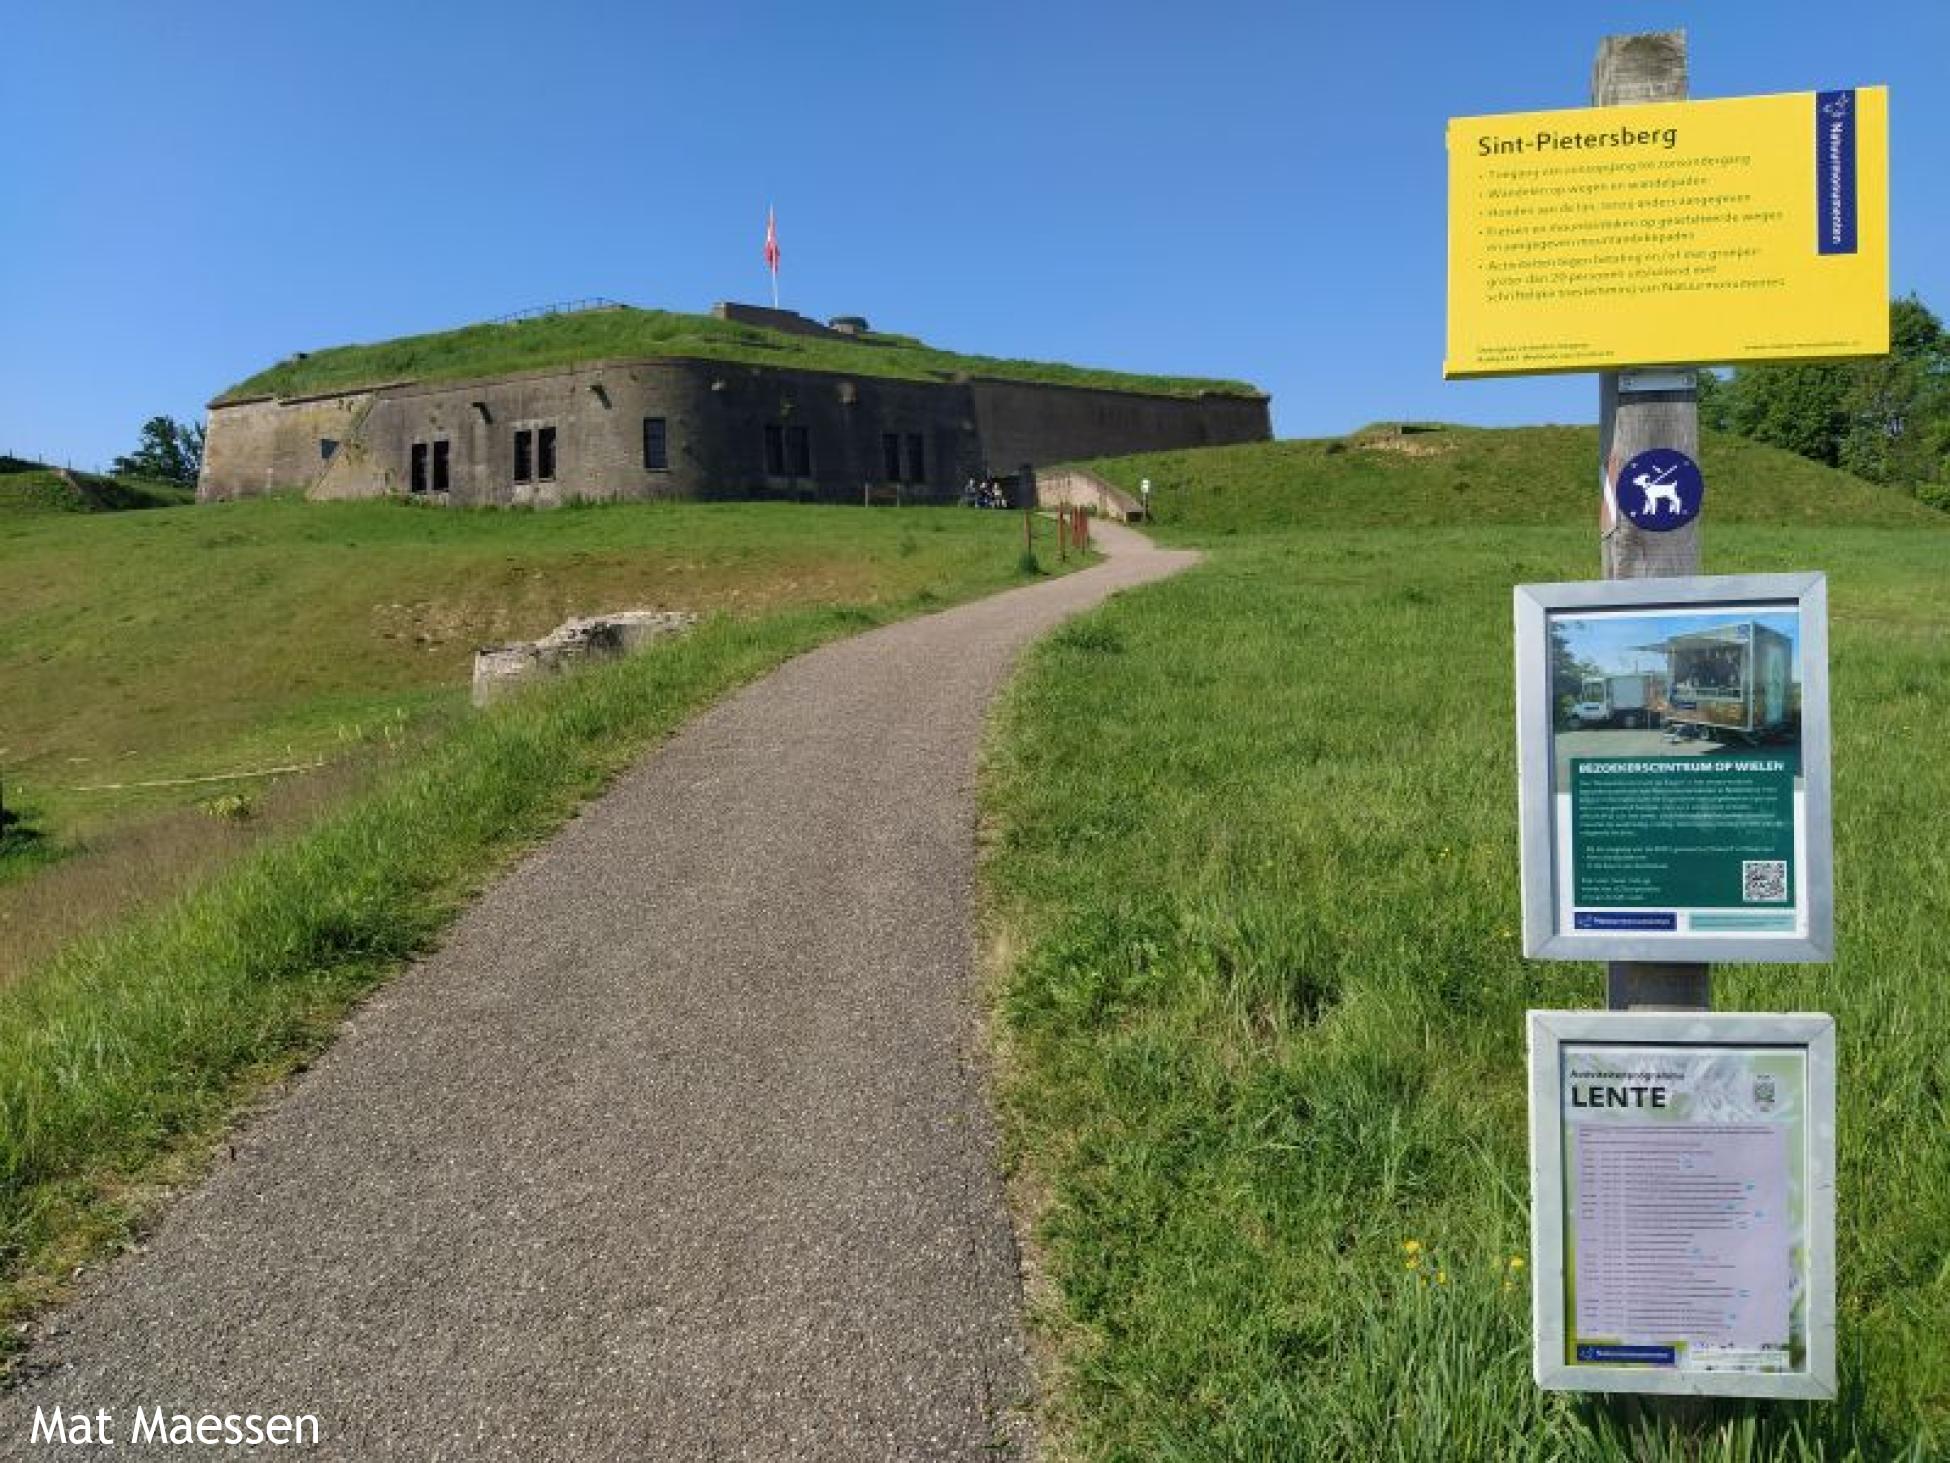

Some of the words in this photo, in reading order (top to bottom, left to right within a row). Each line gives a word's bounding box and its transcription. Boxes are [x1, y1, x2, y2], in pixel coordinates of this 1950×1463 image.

[1479, 126, 1677, 157] Sint-Pietersberg
[1715, 761, 1733, 772] OP
[1735, 760, 1785, 771] WIELEN
[1571, 1086, 1667, 1108] LENTE
